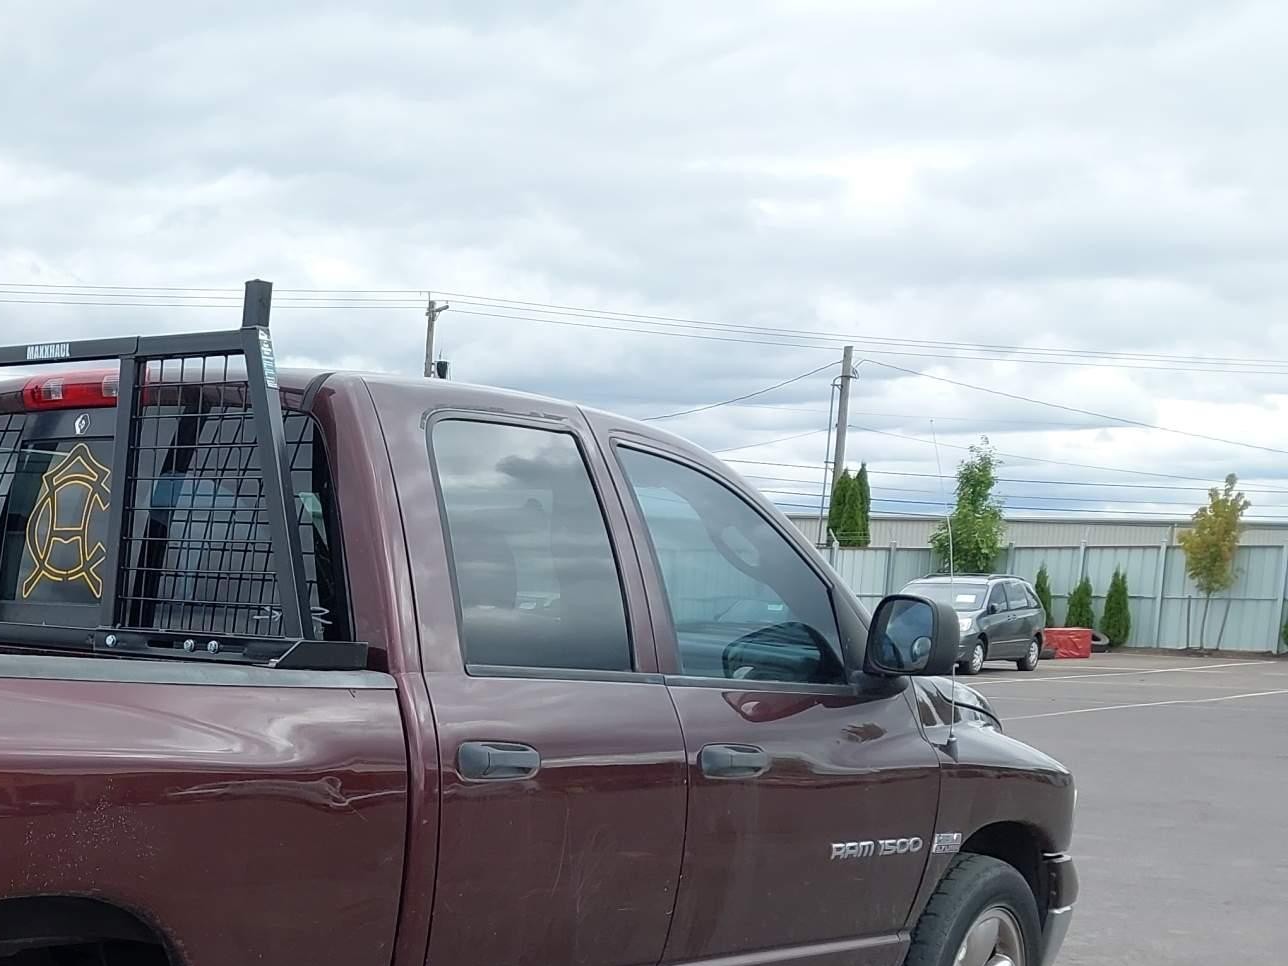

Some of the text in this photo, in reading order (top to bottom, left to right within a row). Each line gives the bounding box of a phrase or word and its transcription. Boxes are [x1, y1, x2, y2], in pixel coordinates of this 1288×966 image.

[26, 343, 70, 360] MAXXHAUL
[831, 842, 874, 859] RAM
[879, 837, 922, 856] 1500
